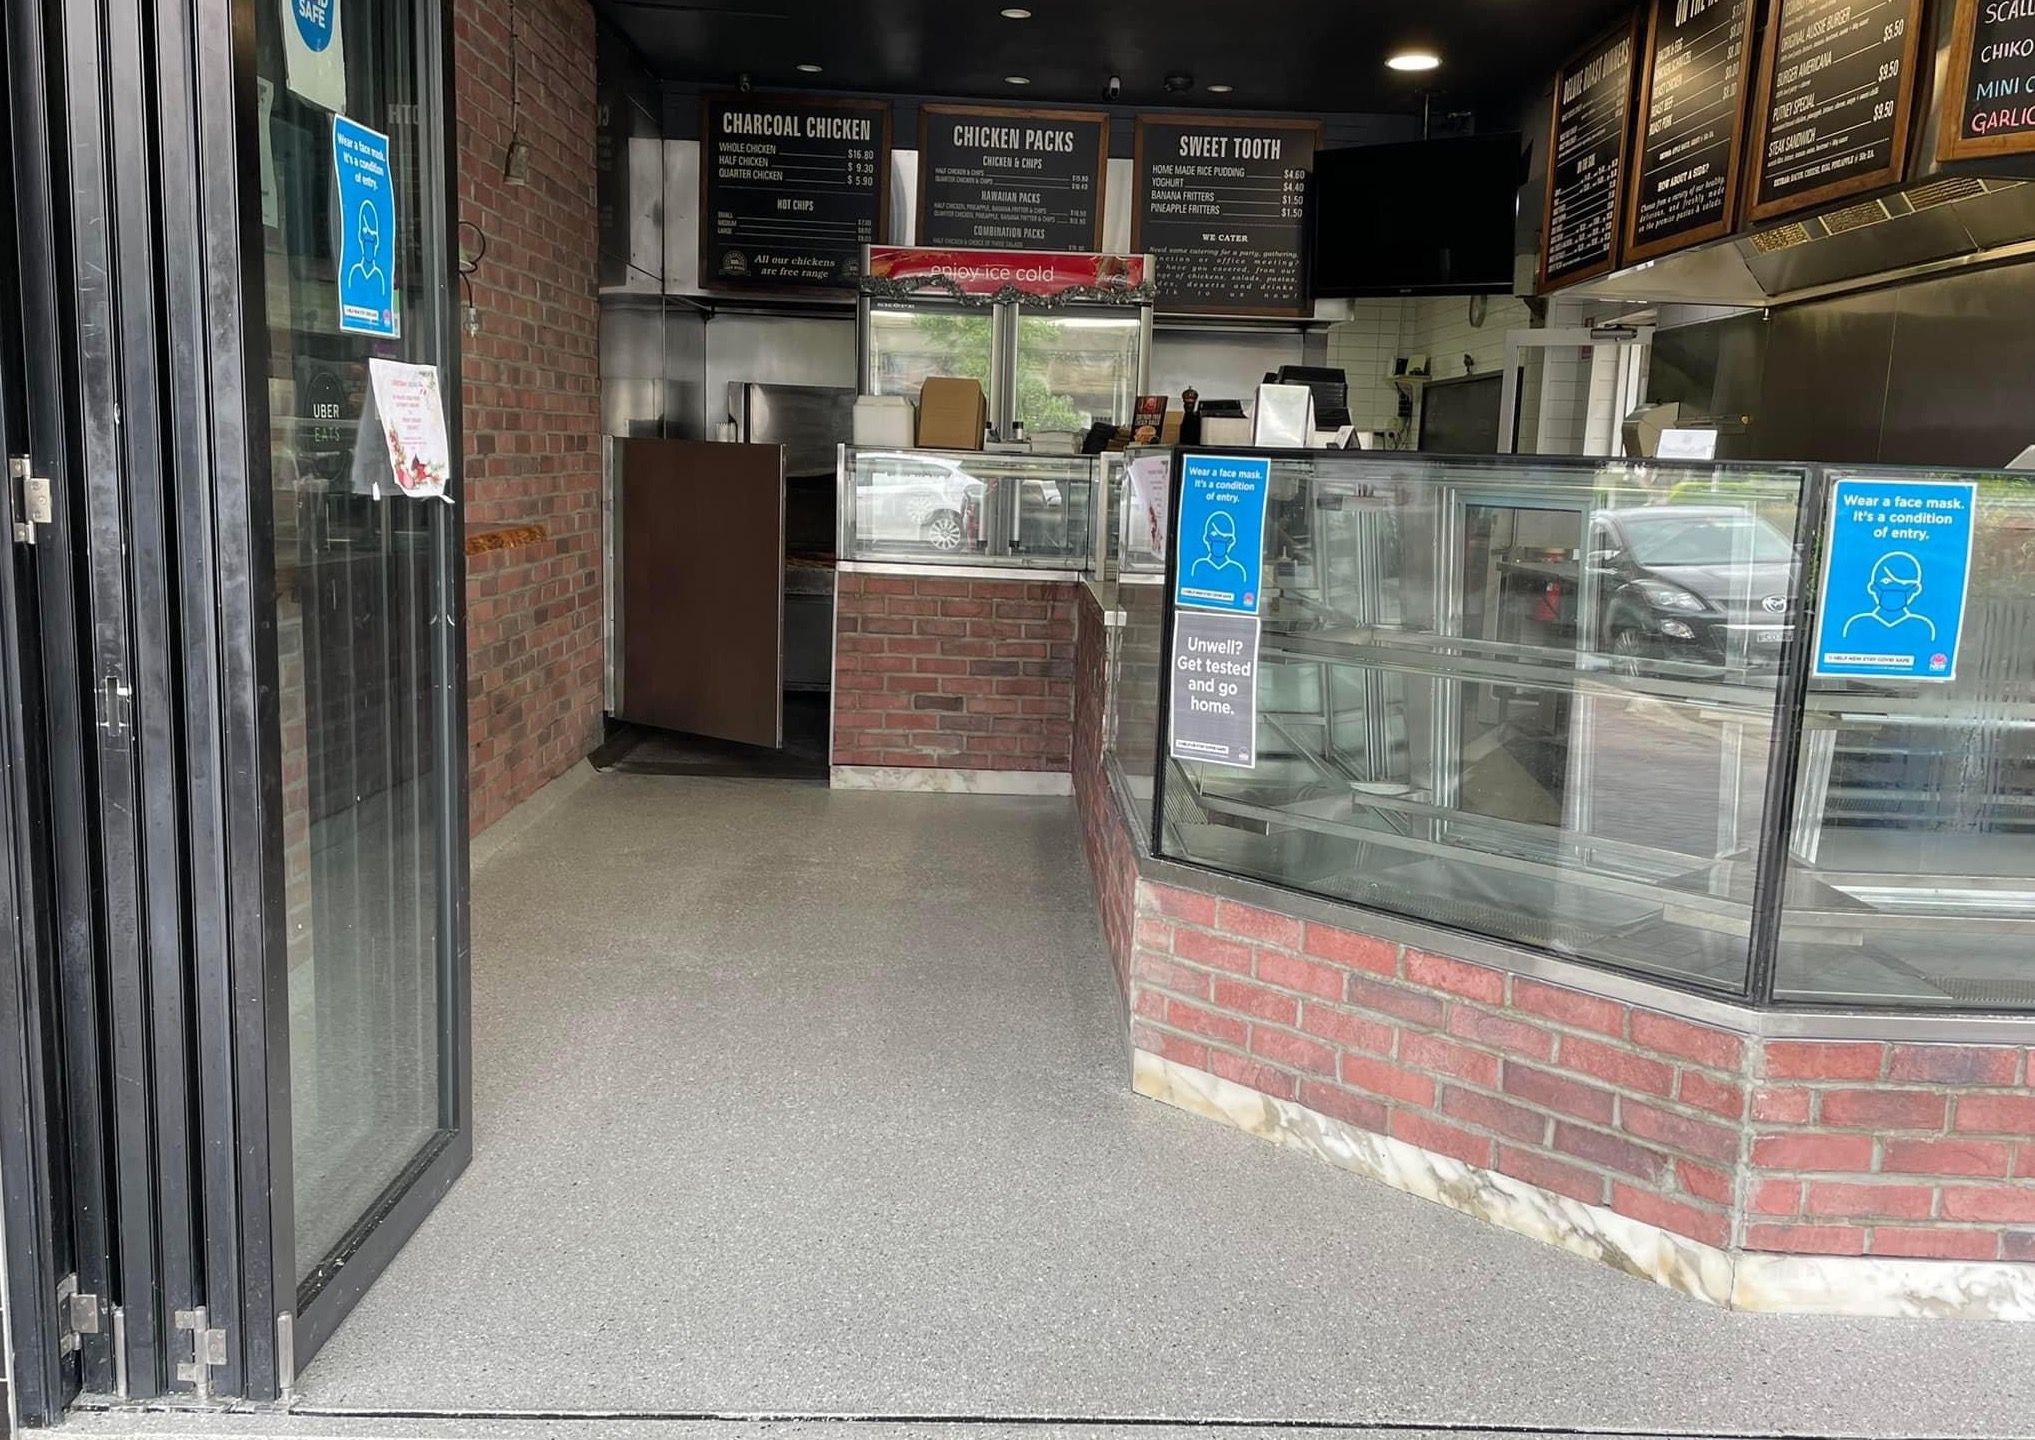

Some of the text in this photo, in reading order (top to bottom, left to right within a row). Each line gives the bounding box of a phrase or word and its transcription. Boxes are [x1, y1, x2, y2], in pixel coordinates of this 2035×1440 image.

[299, 0, 326, 29] SAFE
[1675, 0, 1688, 27] ON
[1781, 29, 1805, 53] ORIGINAL
[1806, 17, 1827, 40] AUSSIE
[1826, 6, 1851, 31] BURGER
[1981, 38, 2034, 63] CHIKO
[1776, 50, 1832, 88] BURGER AMERICANA
[1976, 77, 2019, 101] MINI
[1773, 101, 1793, 122] PUTNEY
[1793, 92, 1815, 115] SPECIAL
[723, 112, 871, 141] CHARCOAL CHICKEN
[1971, 105, 2035, 134] GARLIC
[953, 125, 1075, 153] CHICKEN PACKS
[1768, 138, 1785, 158] STEAK
[1785, 127, 1816, 151] SANDWICH
[719, 142, 874, 160] WHOLE CHICKEN $16.80
[1179, 135, 1281, 160] SWEET TOOTH
[719, 155, 737, 165] HALF
[738, 156, 768, 167] CHICKEN
[982, 155, 1043, 170] CHICKEN & CHIPS
[719, 168, 783, 181] QUARTER CHICKEN
[1152, 164, 1173, 175] HOME
[1174, 165, 1195, 176] MADE
[1197, 166, 1212, 176] RICE
[1213, 167, 1245, 178] PUDDING
[1657, 162, 1710, 193] HOW ABOUT A SIDE?
[1152, 177, 1305, 192] YOGHURT $4.40
[777, 199, 814, 211] HOT CHIPS
[981, 190, 1041, 204] HAWAIIAN PACKS
[1151, 190, 1304, 206] BANANA FRITTERS $1.50
[1669, 201, 1680, 212] and
[1708, 186, 1725, 198] made
[1150, 202, 1303, 218] PINEAPPLE FRITTERS $1.50
[973, 225, 1045, 240] COMBINATION PACKS
[1202, 233, 1248, 242] WE CATER
[1189, 248, 1219, 256] catering
[1219, 247, 1231, 256] for
[754, 254, 835, 267] All our chickens
[1254, 259, 1299, 267] meeting?
[761, 267, 829, 280] are free range
[931, 263, 1054, 281] enjoy ice cold
[1255, 266, 1275, 274] from
[313, 404, 339, 419] UBER
[315, 426, 340, 442] EATS
[1189, 467, 1210, 477] Wear
[1219, 468, 1236, 478] face
[1239, 470, 1263, 479] mask.
[1194, 479, 1207, 488] It's
[1215, 480, 1255, 491] condition
[1206, 492, 1240, 503] of entry.
[1843, 495, 1965, 510] Wear a face mask.
[1878, 514, 1885, 522] a
[1889, 512, 1953, 524] condition
[1873, 526, 1929, 541] of entry.
[1187, 636, 1243, 655] Unwell?
[1177, 656, 1251, 677] Get tested
[1188, 678, 1238, 697] and go
[1190, 696, 1235, 715] home.
